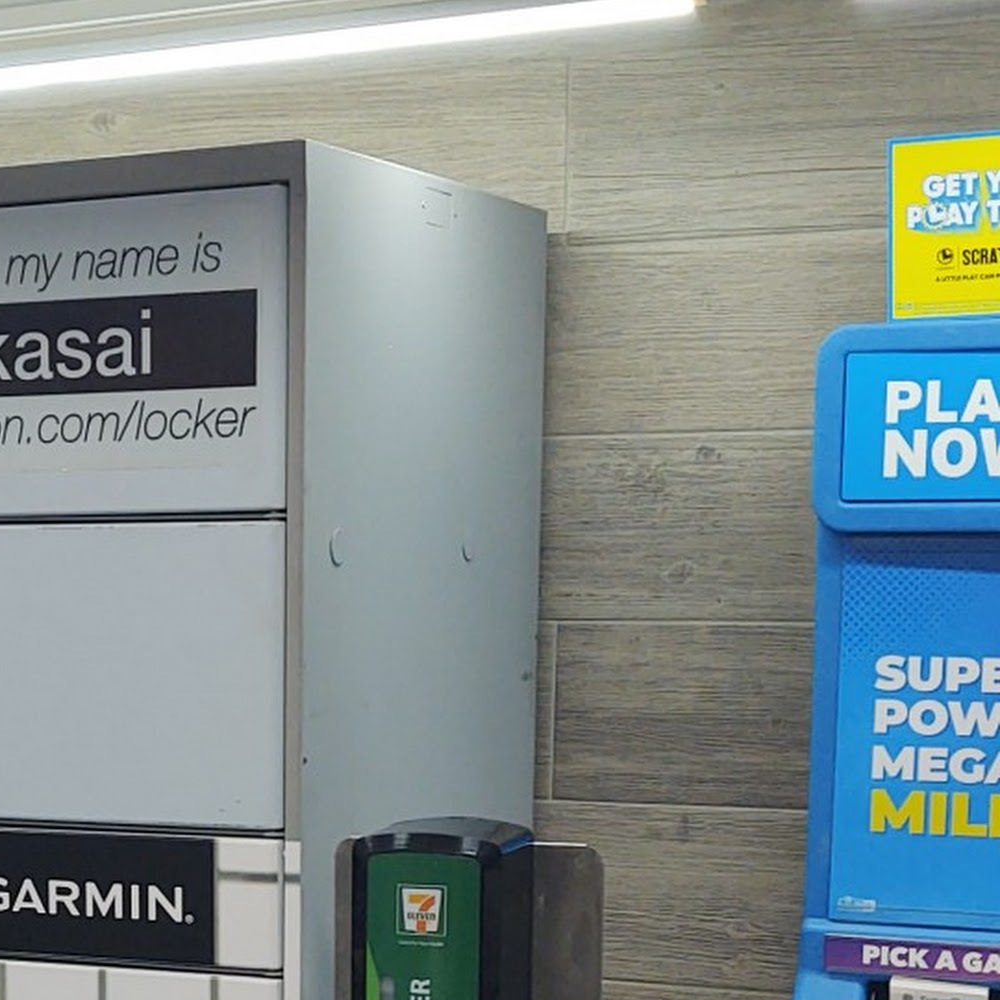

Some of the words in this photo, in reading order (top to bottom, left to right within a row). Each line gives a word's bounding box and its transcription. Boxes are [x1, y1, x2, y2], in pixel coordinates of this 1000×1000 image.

[923, 172, 978, 198] GET
[907, 200, 979, 229] PLAY
[5, 249, 62, 293] my
[72, 240, 179, 282] name
[191, 232, 223, 274] is
[884, 378, 1000, 424] PLA
[874, 655, 1000, 693] SUPE
[873, 698, 1000, 738] POW
[862, 944, 928, 969] PICK
[934, 949, 958, 972] A
